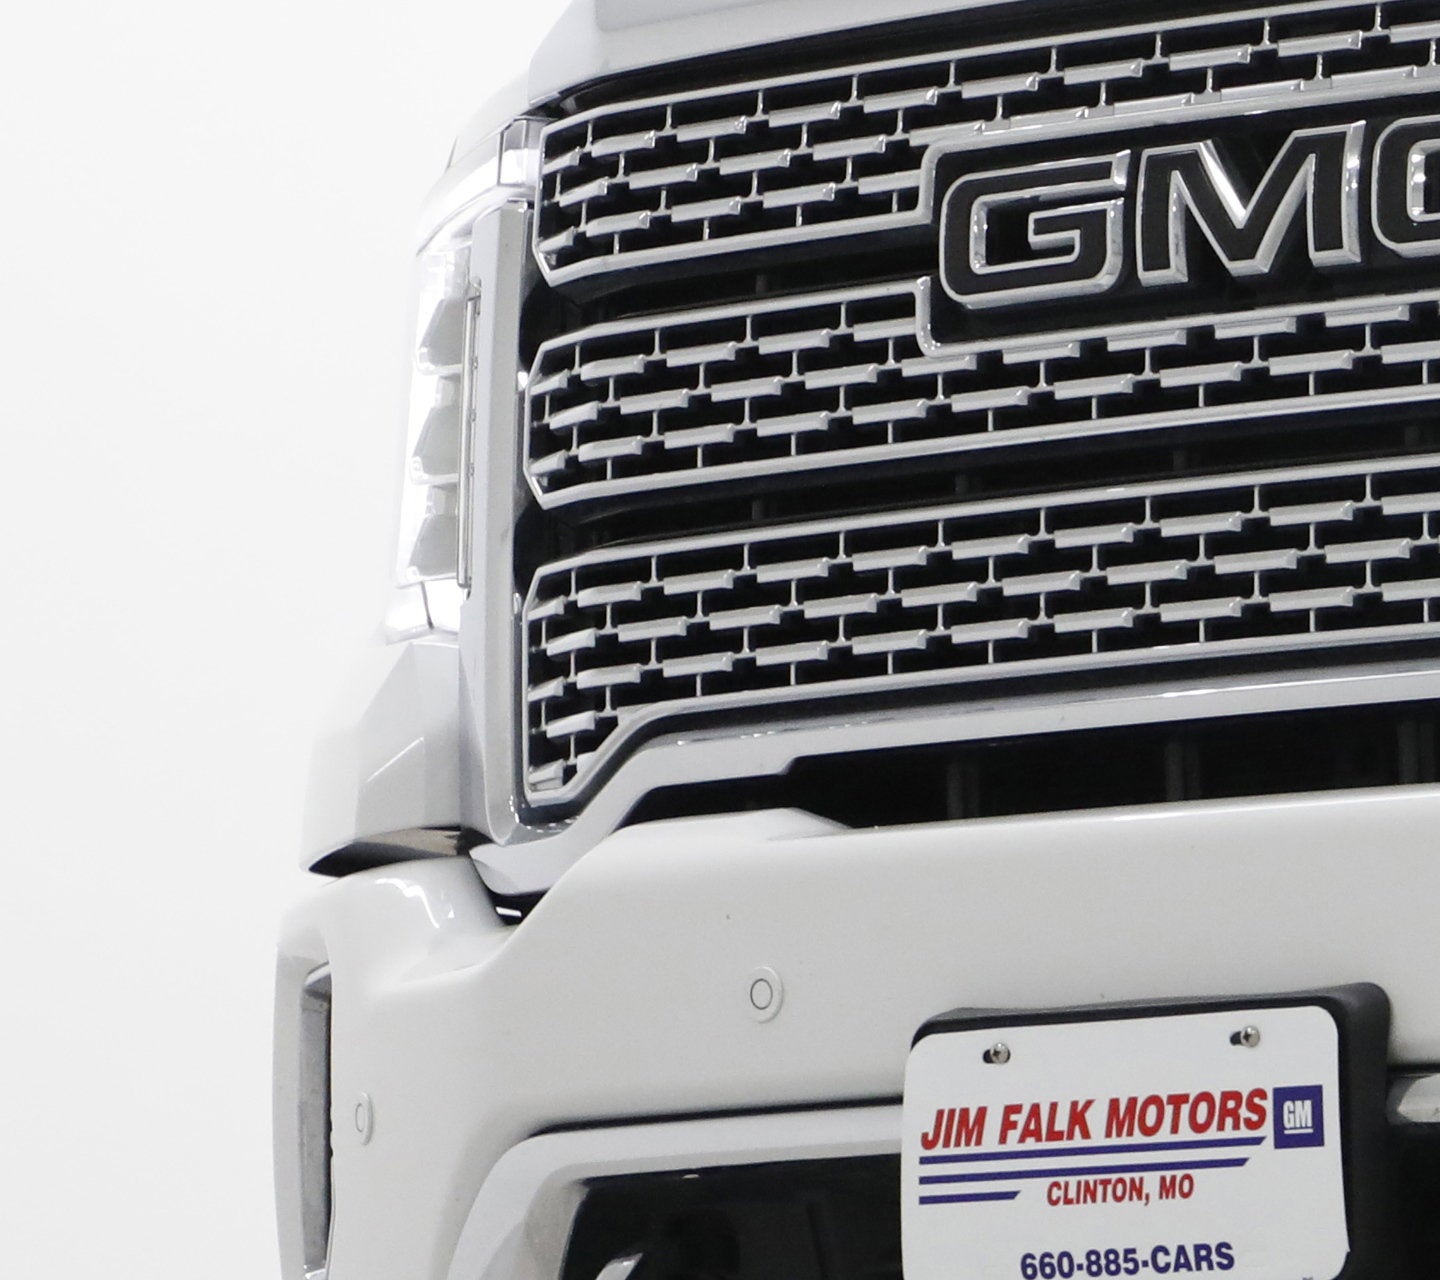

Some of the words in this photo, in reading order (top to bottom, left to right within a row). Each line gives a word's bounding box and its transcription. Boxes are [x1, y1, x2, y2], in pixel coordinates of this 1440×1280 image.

[921, 1106, 988, 1151] JIM
[998, 1098, 1096, 1145] FALK
[1104, 1087, 1269, 1139] MOTORS
[1282, 1099, 1313, 1129] GM
[1046, 1176, 1151, 1207] CLINTON,
[1158, 1173, 1195, 1201] MO
[1020, 1241, 1236, 1280] 660-885-CARS
